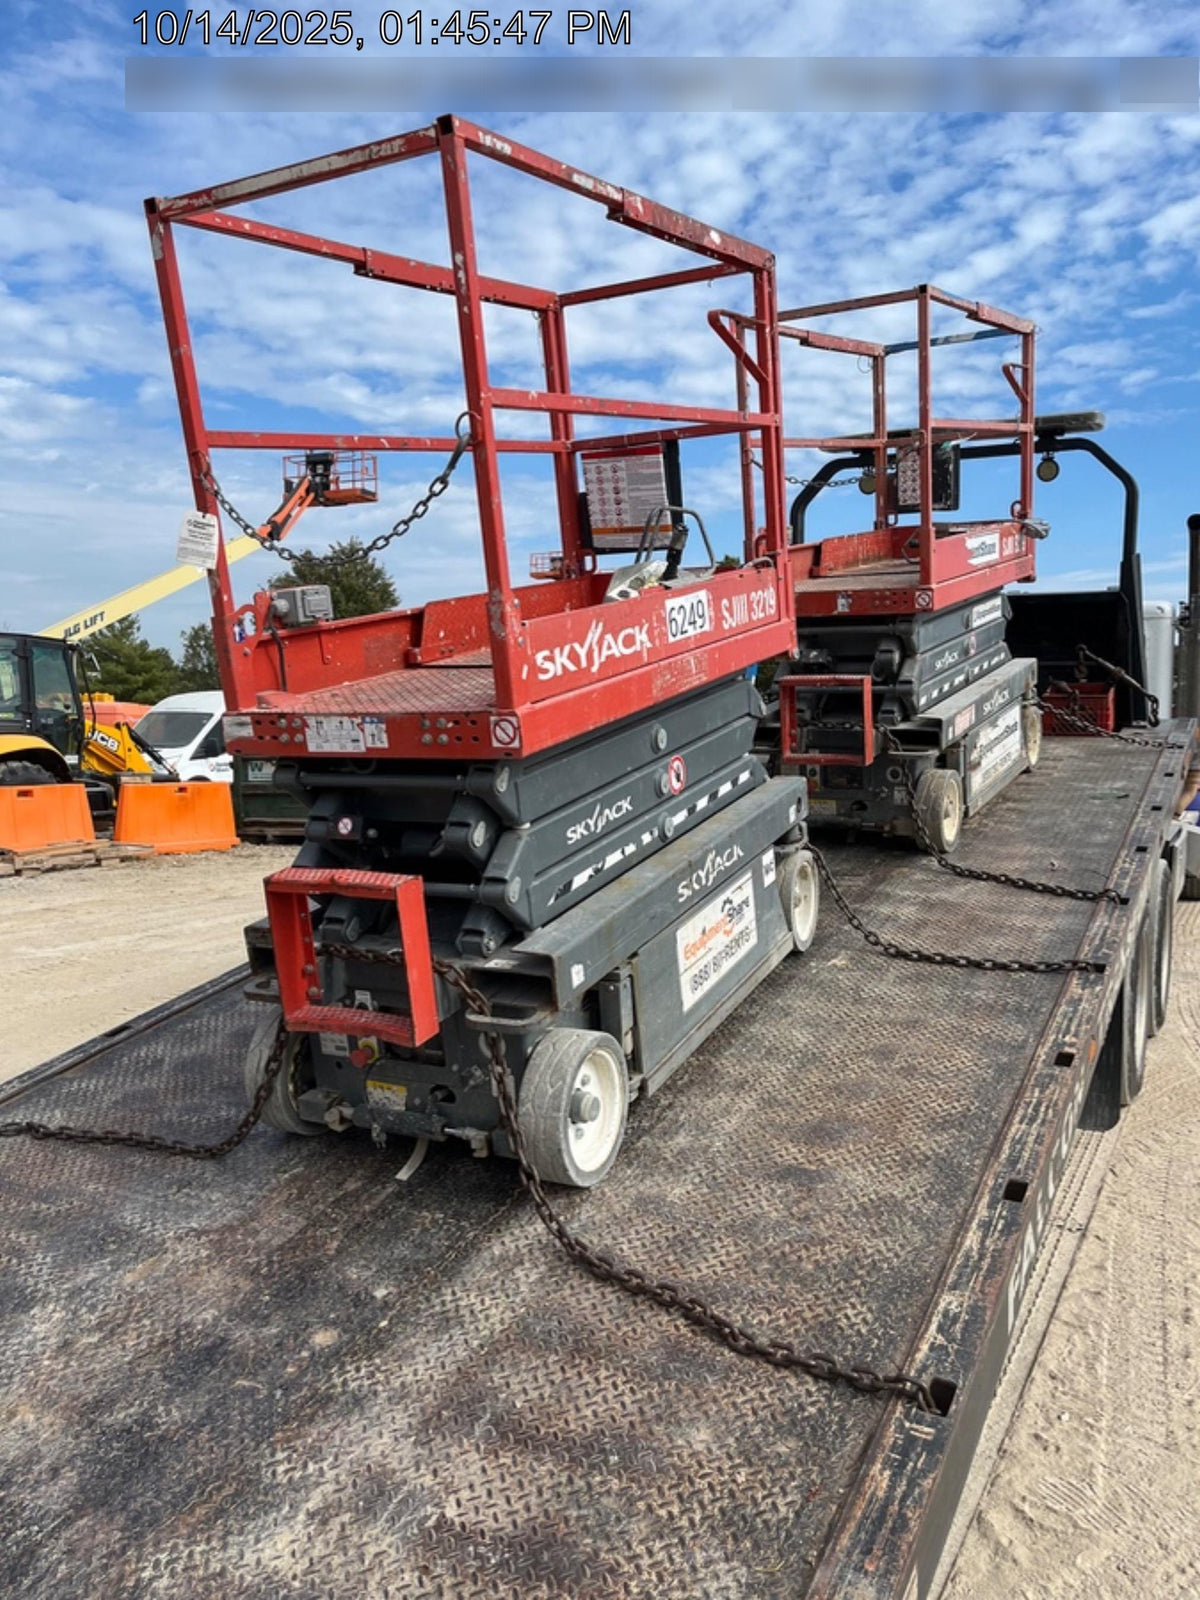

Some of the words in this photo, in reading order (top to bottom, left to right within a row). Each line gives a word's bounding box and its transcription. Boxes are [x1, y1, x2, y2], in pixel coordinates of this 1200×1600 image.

[668, 599, 707, 639] 6249
[750, 585, 776, 621] 3219
[64, 622, 81, 639] JLG
[84, 611, 105, 630] LIFT
[534, 619, 653, 681] SKYJACK
[88, 730, 119, 751] JCB
[566, 796, 633, 845] SKYJACK
